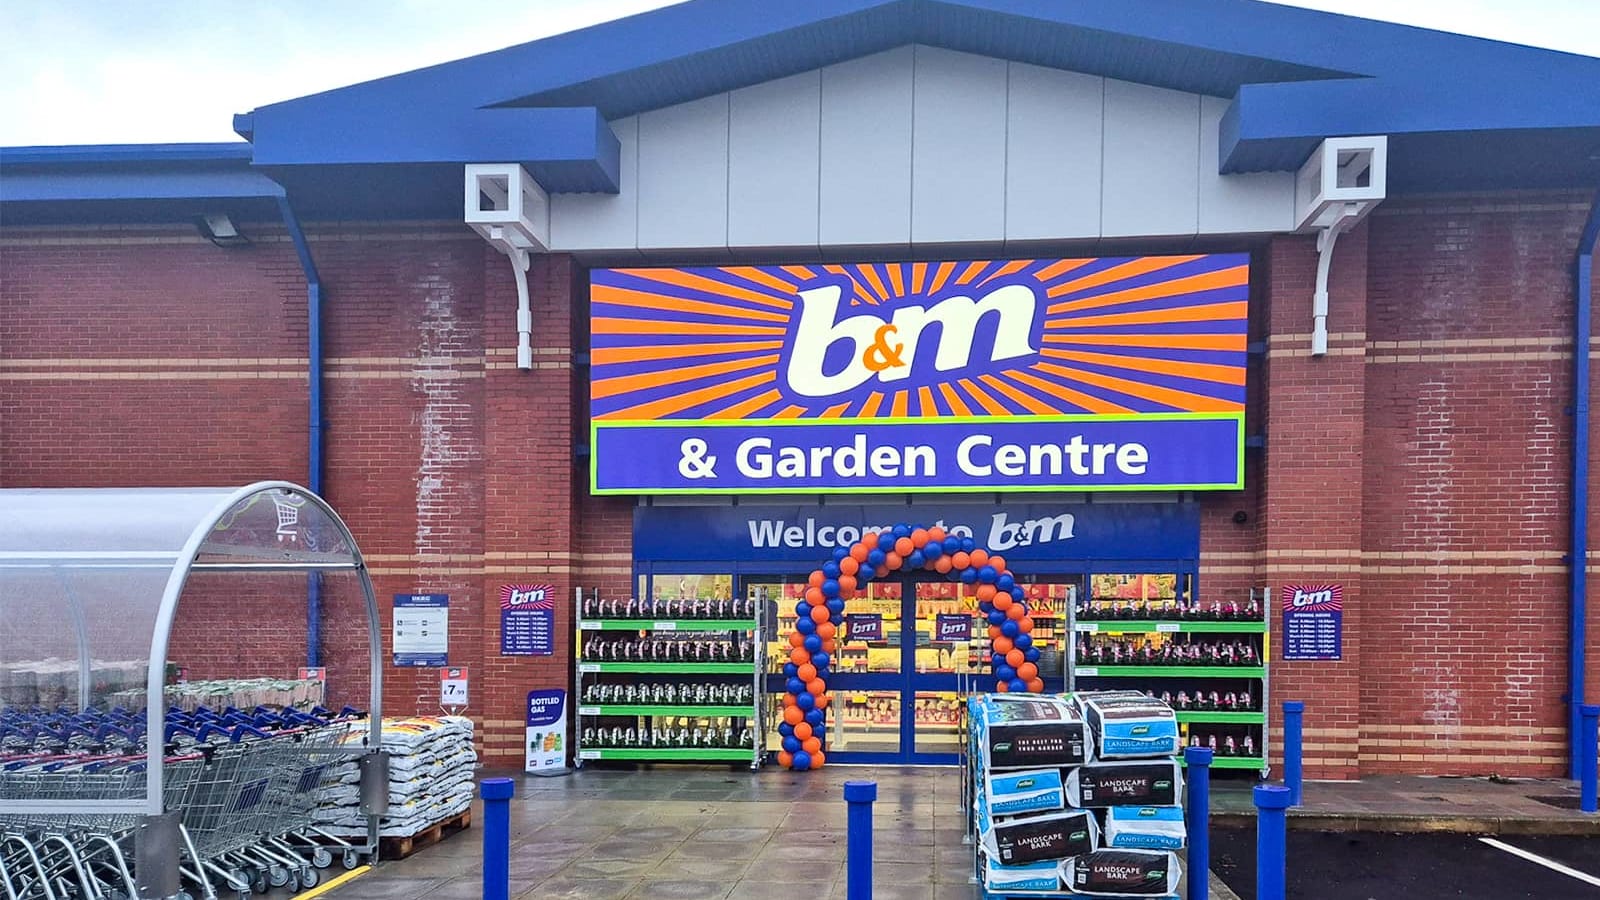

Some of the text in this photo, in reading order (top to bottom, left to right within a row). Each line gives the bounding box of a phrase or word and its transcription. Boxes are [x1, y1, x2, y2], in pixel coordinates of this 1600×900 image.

[787, 284, 1039, 397] b&m
[678, 434, 1149, 479] & Garden Centre
[987, 512, 1075, 551] b&m
[531, 696, 560, 706] BOTTLED
[531, 706, 545, 714] GAS
[1100, 779, 1147, 788] LANDSCAPE
[1017, 832, 1063, 846] LANDSCAPE
[1031, 840, 1052, 850] BARK
[1094, 865, 1140, 875] LANDSCAPE
[1106, 872, 1128, 880] BARK
